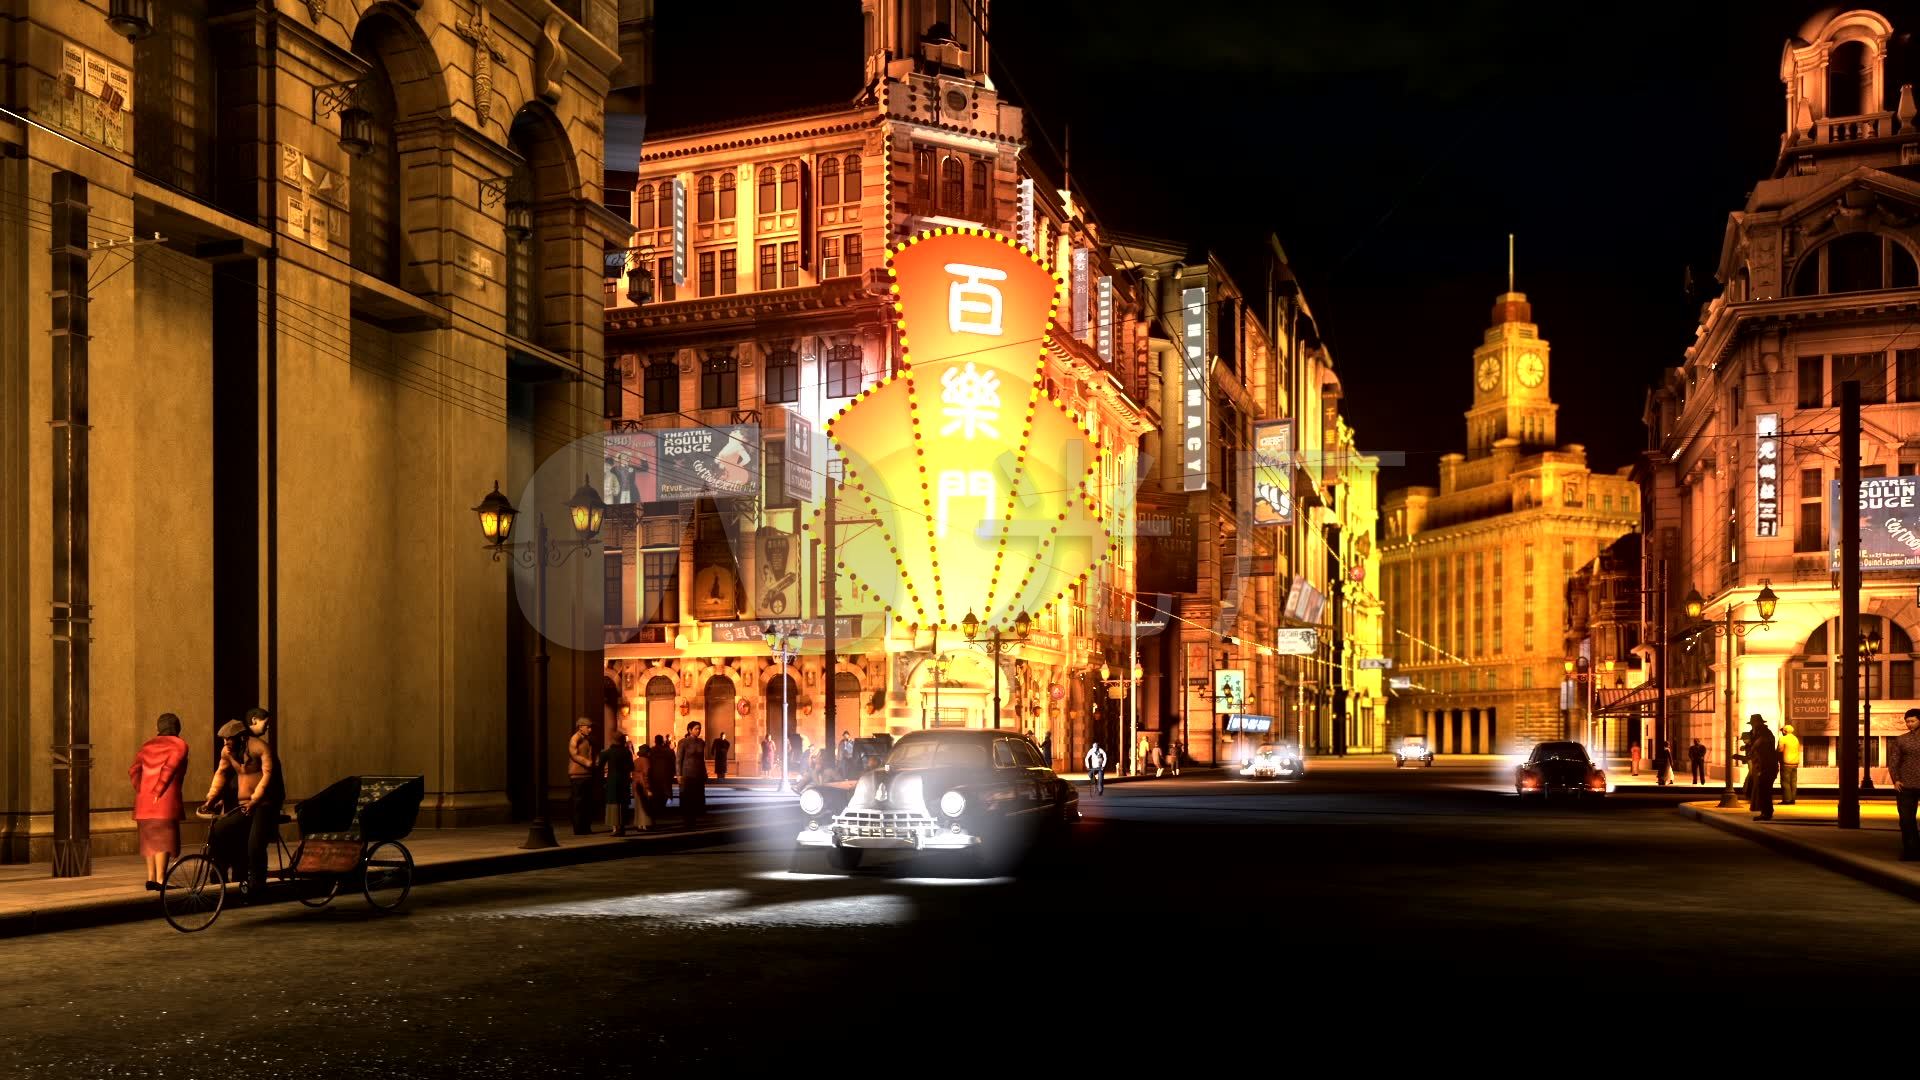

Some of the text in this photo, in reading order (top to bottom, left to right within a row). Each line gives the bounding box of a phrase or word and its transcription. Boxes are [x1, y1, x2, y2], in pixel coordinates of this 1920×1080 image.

[1187, 302, 1201, 472] PHARMACY
[938, 263, 1008, 538] 百樂門
[664, 436, 712, 447] MOULIN
[664, 444, 712, 456] ROUGE
[1859, 497, 1915, 510] OUGE
[1139, 512, 1191, 536] PICTURE
